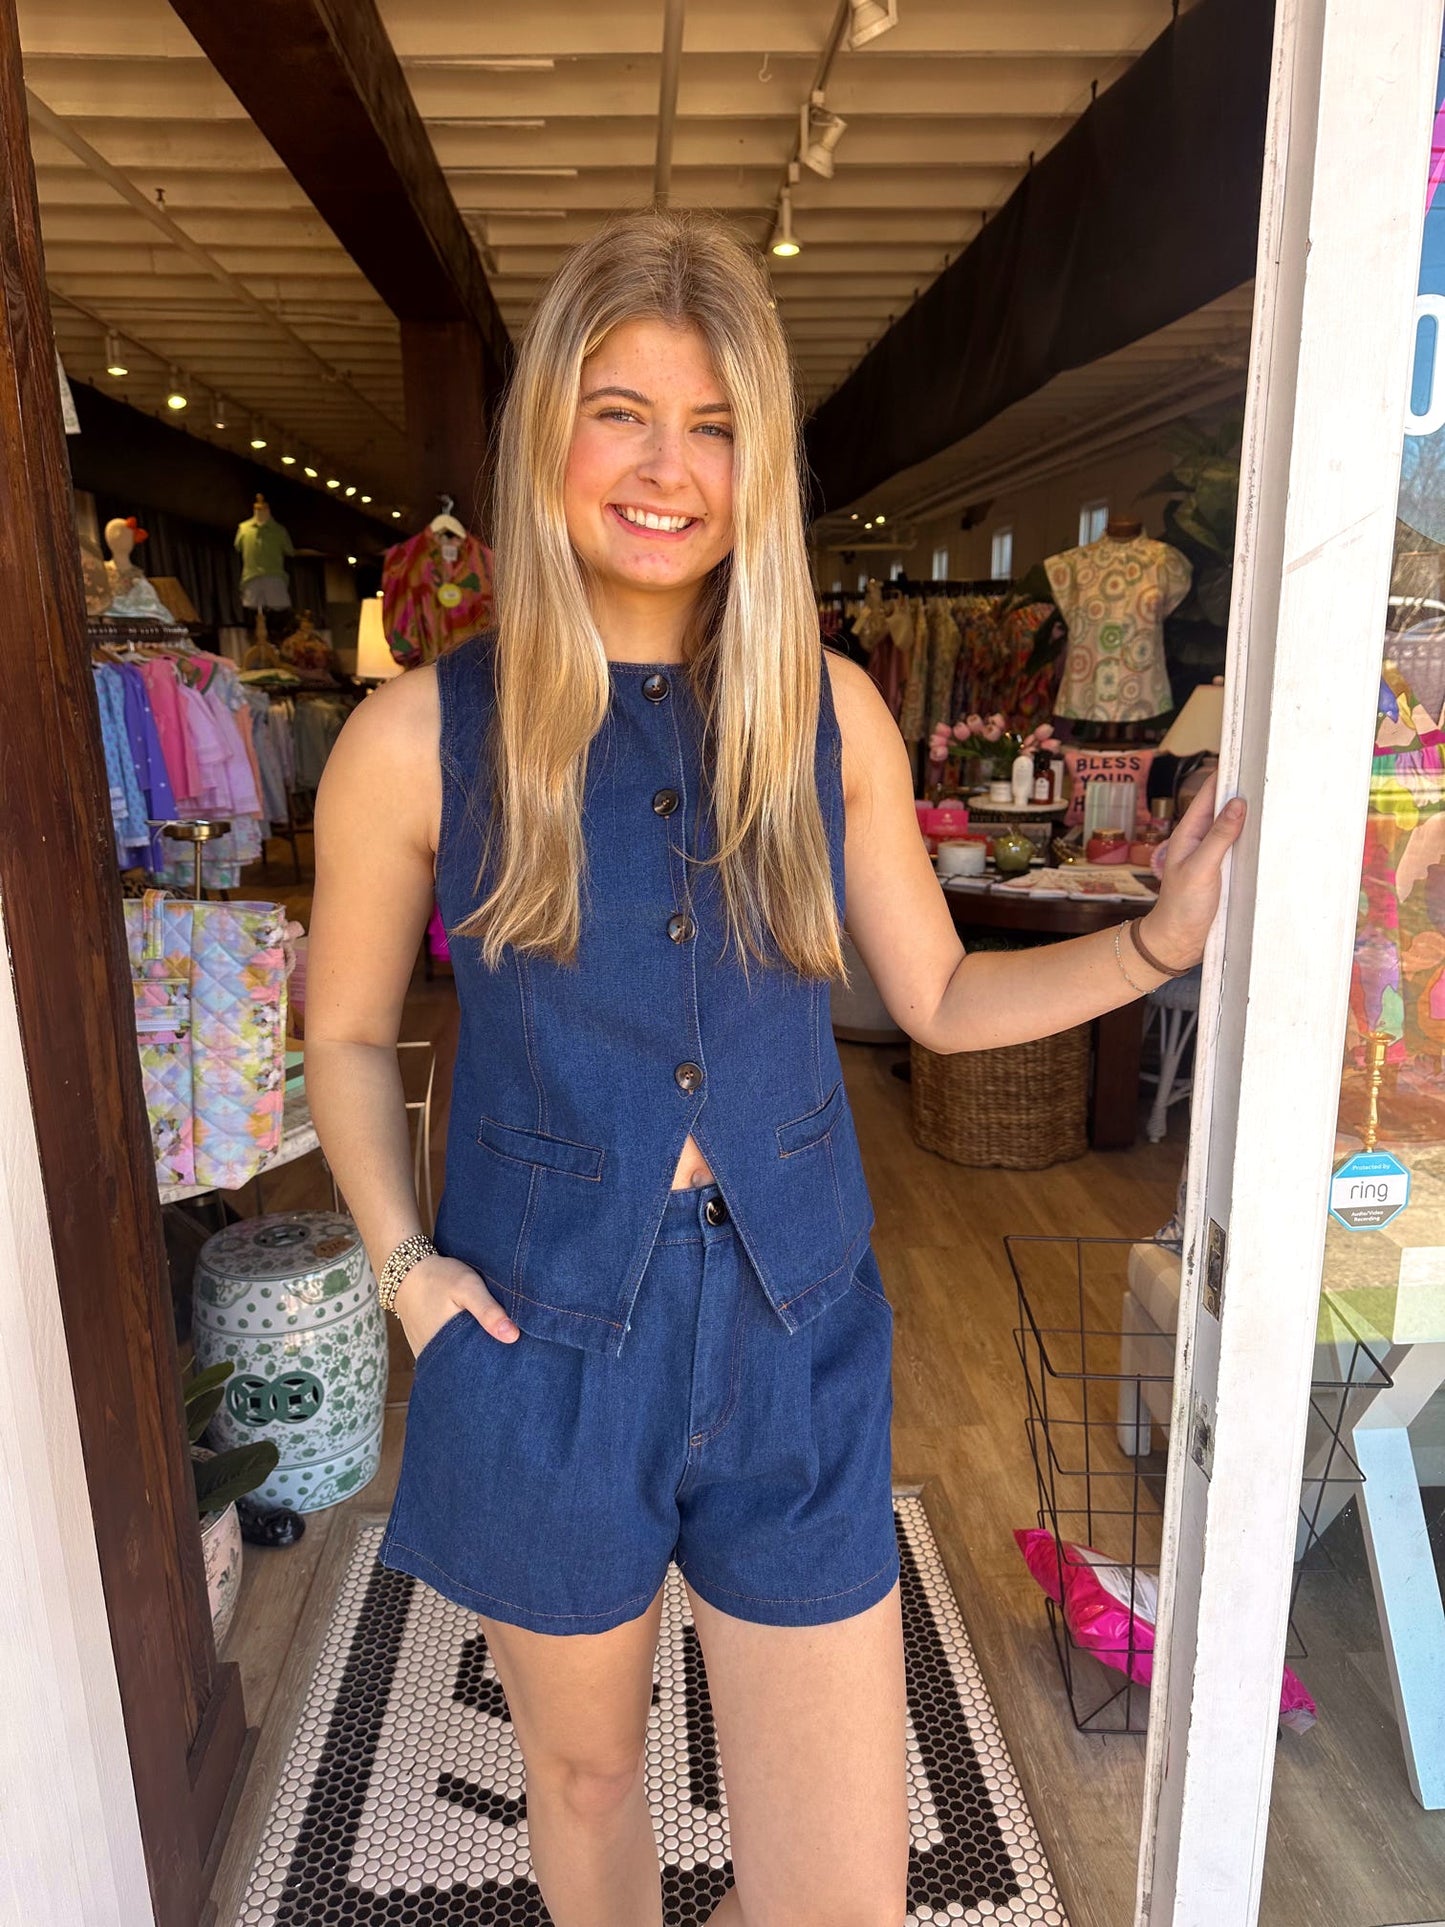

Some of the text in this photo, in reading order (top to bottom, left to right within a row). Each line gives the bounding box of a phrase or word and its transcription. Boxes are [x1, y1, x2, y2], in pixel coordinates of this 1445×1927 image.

[1076, 757, 1141, 772] BLESS
[1352, 1163, 1382, 1171] Protected
[1350, 1181, 1388, 1202] ring
